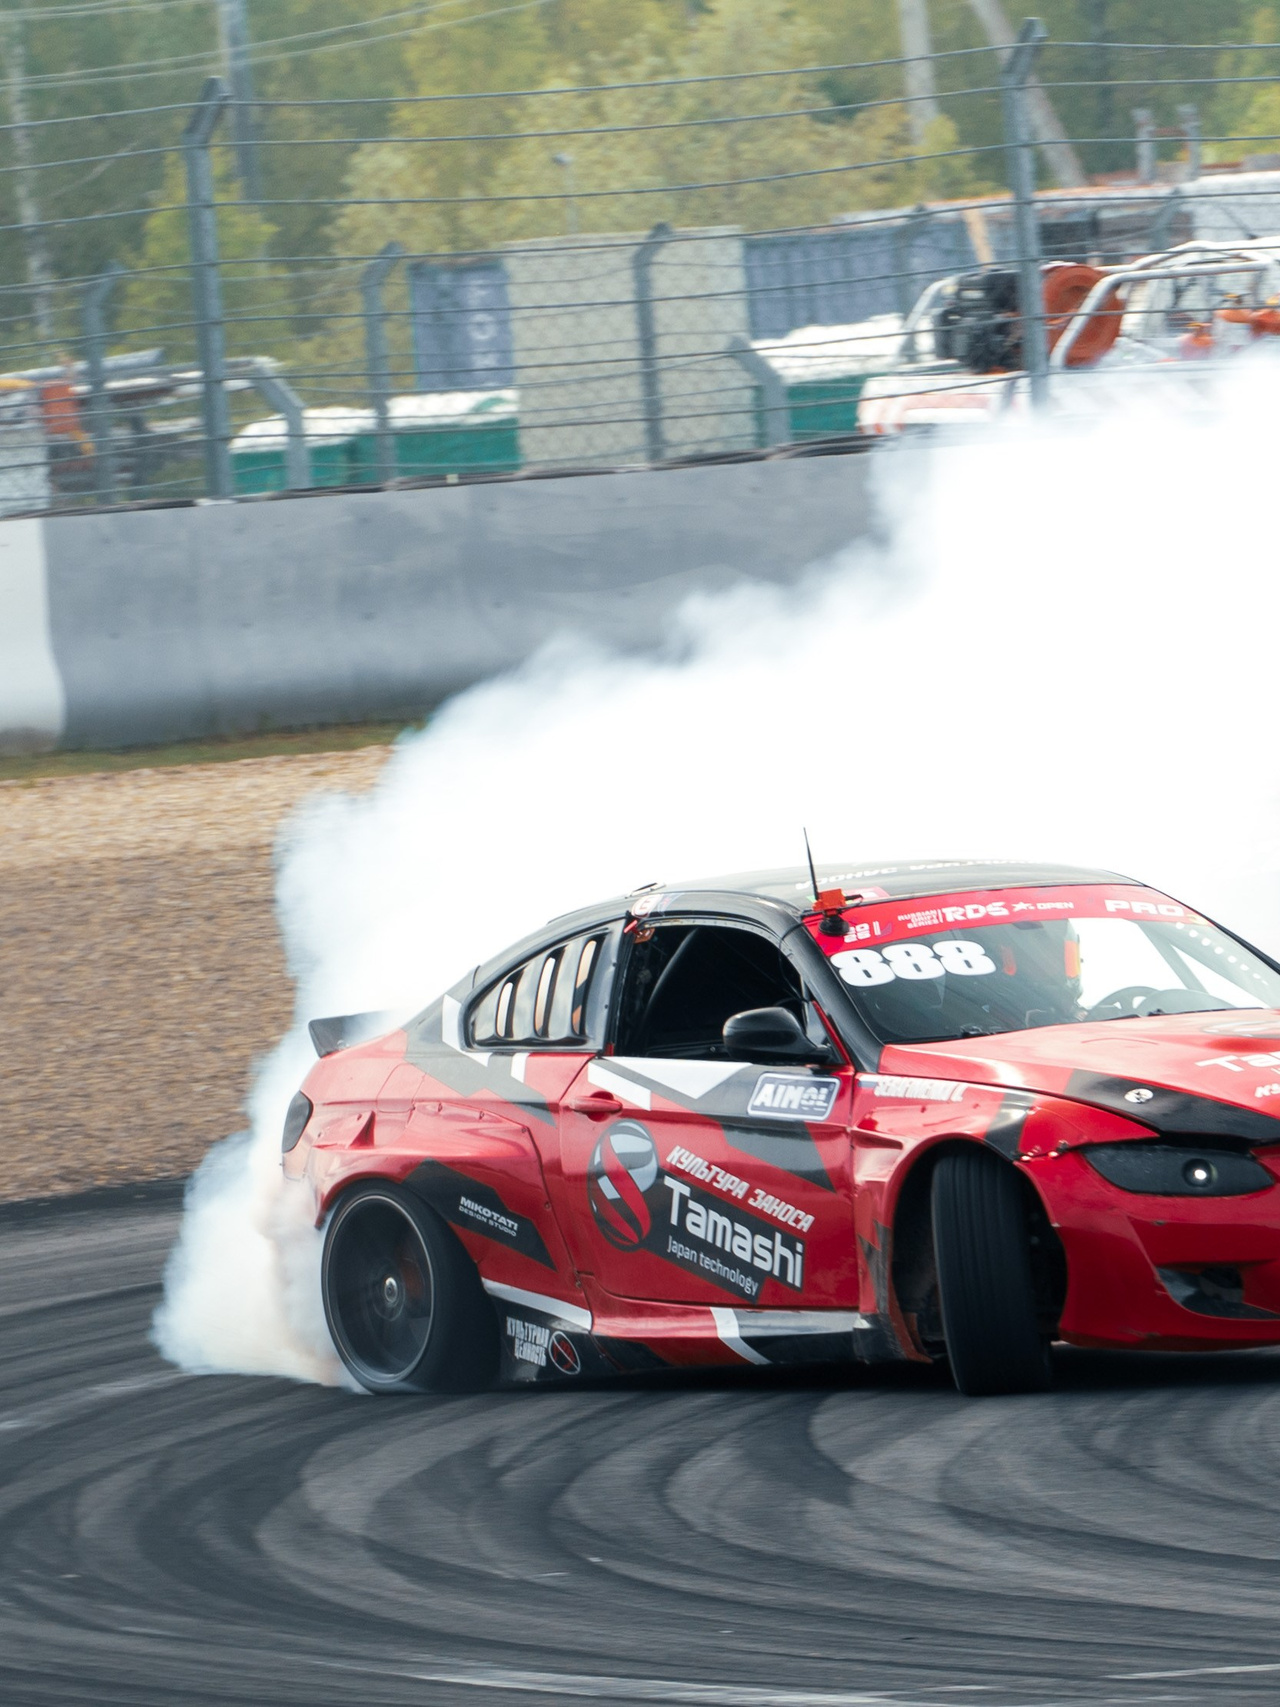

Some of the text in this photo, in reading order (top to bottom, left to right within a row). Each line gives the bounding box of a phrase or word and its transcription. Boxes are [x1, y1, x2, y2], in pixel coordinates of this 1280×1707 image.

[942, 901, 1075, 923] RDS OPEN
[1105, 899, 1185, 917] PRO
[830, 940, 996, 987] 888
[666, 1145, 815, 1232] КУЛЬТУРА ЗАНОСА
[458, 1205, 517, 1237] DESIGN STUDIO
[460, 1196, 519, 1231] MIKOTATI
[664, 1175, 804, 1288] Tamashi
[667, 1235, 759, 1296] Japan technology
